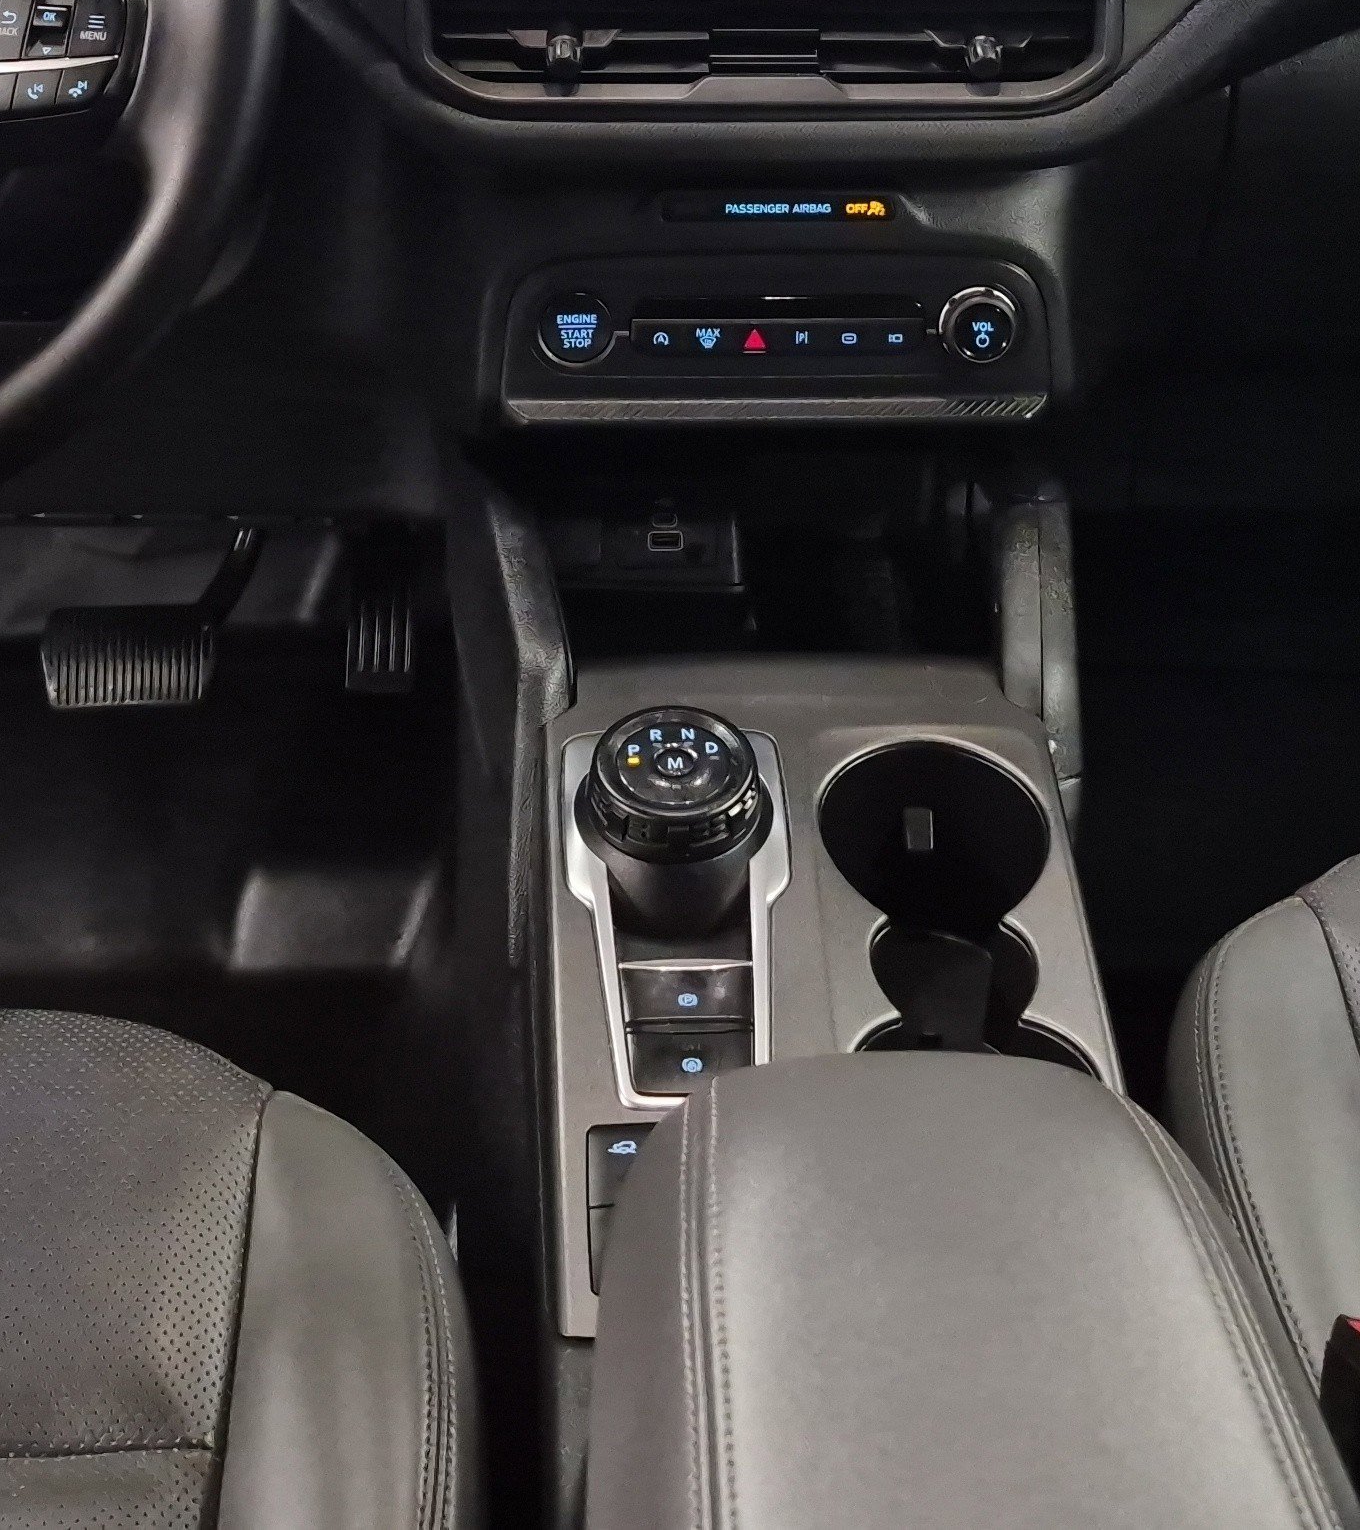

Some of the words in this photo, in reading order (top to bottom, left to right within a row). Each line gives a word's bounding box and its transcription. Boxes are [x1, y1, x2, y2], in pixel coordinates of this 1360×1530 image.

[43, 11, 57, 22] OK
[79, 30, 107, 42] MENU
[725, 203, 789, 214] PASSENGER
[792, 203, 832, 214] AIRBAG
[845, 203, 868, 214] OFF
[556, 314, 598, 325] ENGINE
[972, 321, 994, 332] VOL
[560, 329, 594, 338] START
[695, 327, 721, 338] MAX
[563, 339, 592, 349] STOP
[649, 728, 663, 742] R
[681, 728, 695, 740] N
[627, 744, 640, 756] P
[705, 741, 719, 754] D
[667, 756, 684, 769] M
